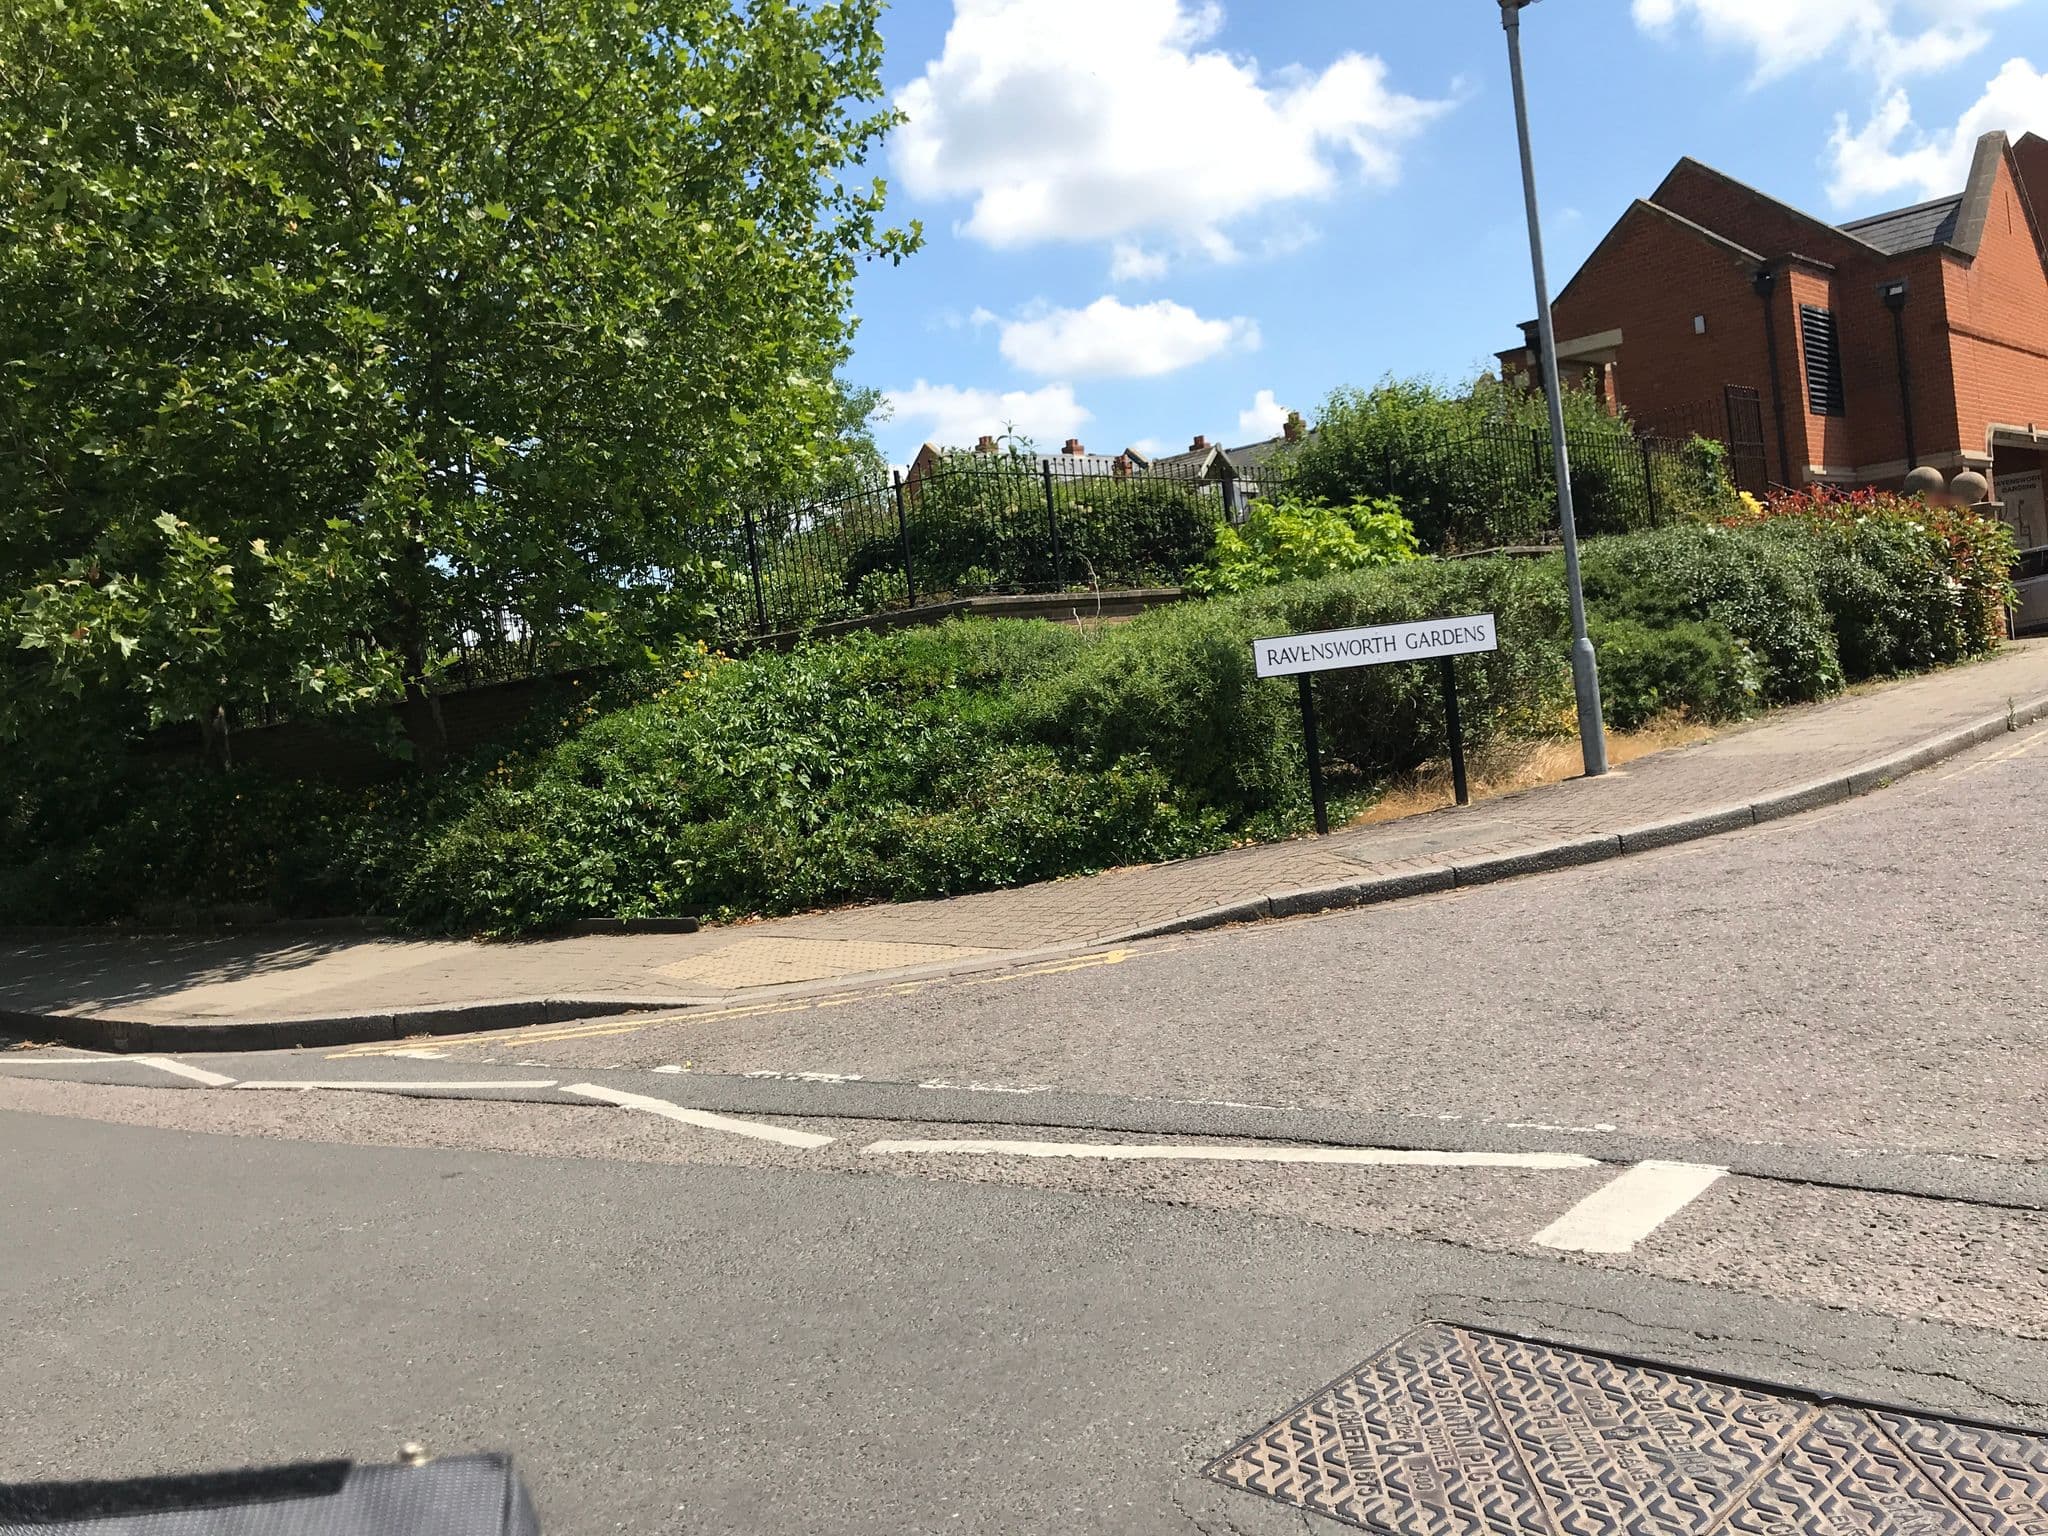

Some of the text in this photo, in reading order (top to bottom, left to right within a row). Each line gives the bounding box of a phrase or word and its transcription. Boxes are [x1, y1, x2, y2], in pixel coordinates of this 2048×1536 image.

[1267, 625, 1486, 666] RAVENSWORTH GARDENS
[1337, 1411, 1384, 1496] CHIEFTAIN 675
[1424, 1425, 1456, 1467] DUCTILE
[1435, 1390, 1494, 1482] STANTON PLC
[1529, 1403, 1601, 1498] STANTON PLC
[1566, 1416, 1604, 1455] DUCTILE
[1631, 1389, 1709, 1473] CHIEFTAIN 675
